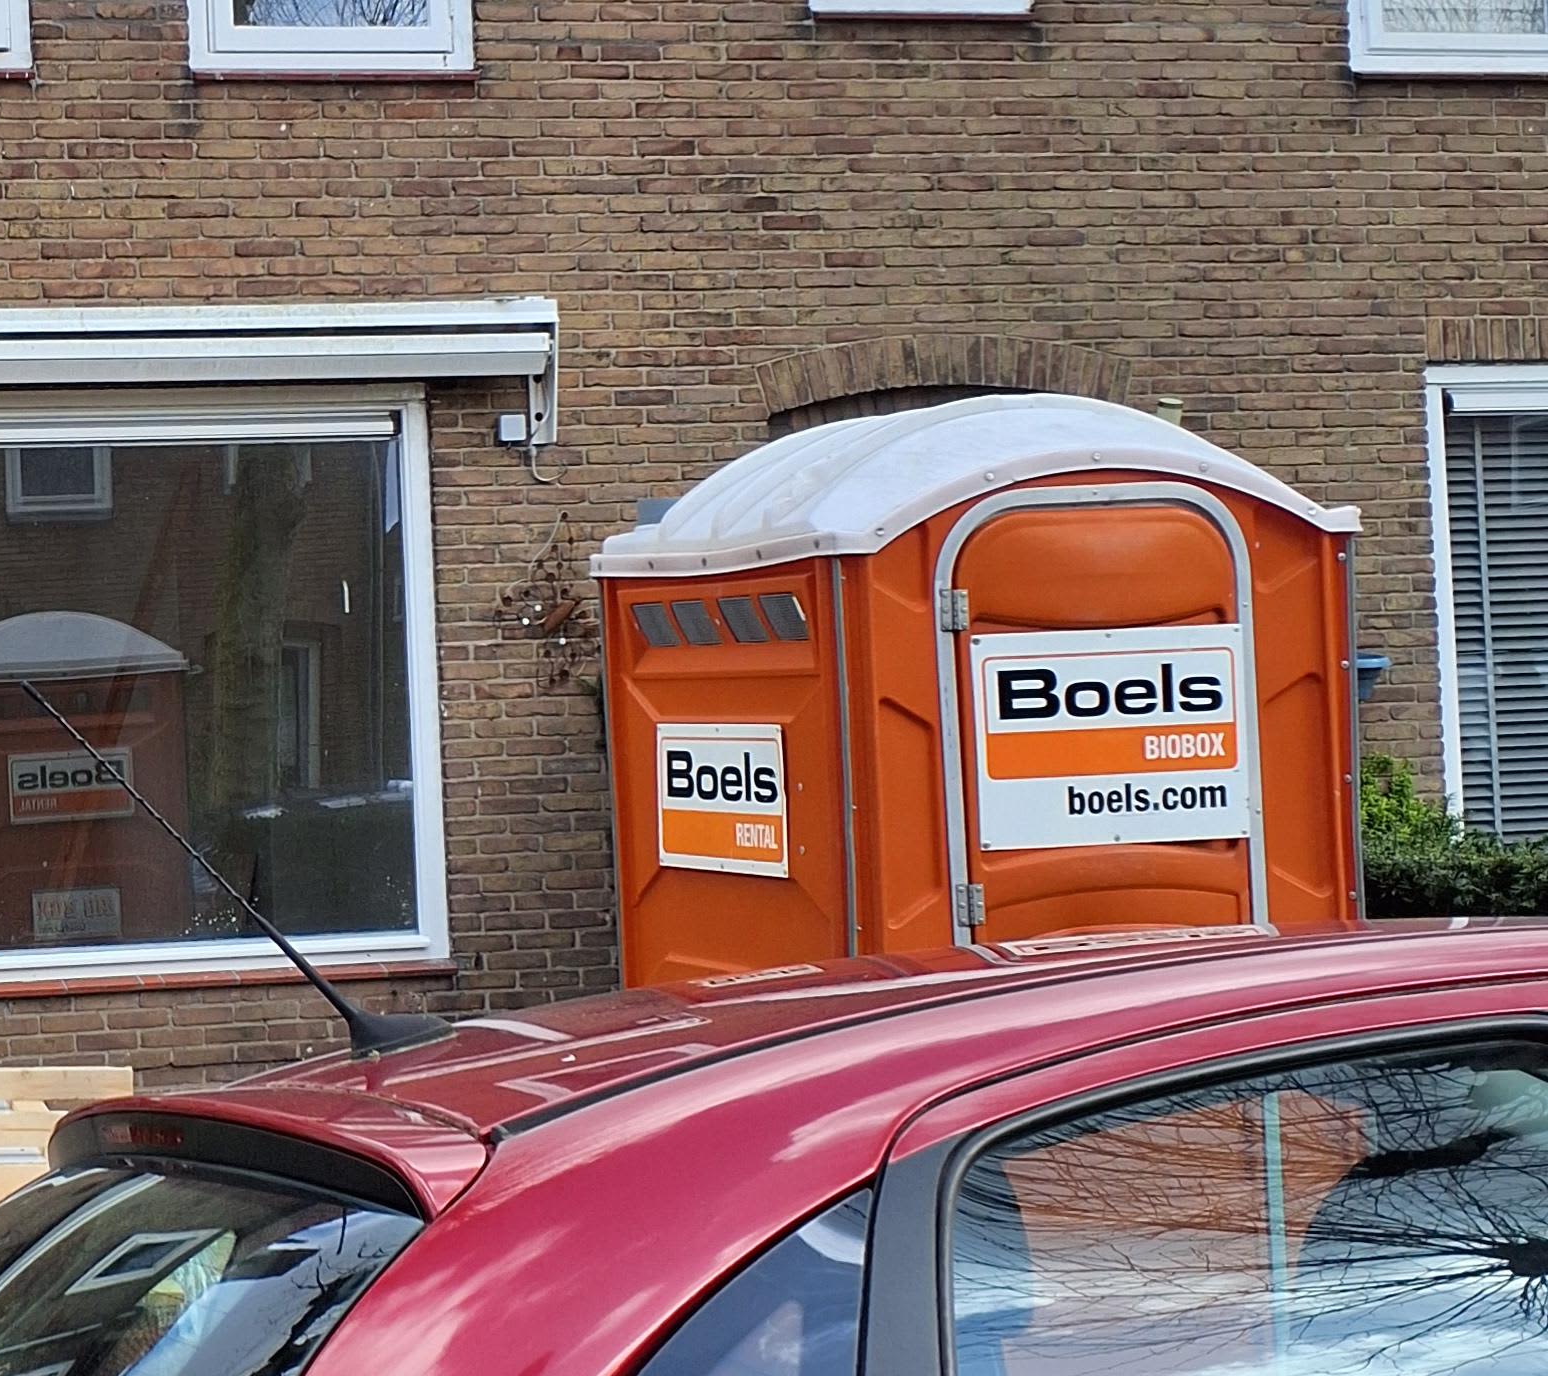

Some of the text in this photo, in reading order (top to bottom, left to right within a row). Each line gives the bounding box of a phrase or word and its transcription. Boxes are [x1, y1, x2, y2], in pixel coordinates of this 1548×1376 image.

[997, 663, 1224, 720] Boels
[1143, 732, 1226, 760] BIOBOX
[666, 750, 779, 803] Boels
[1067, 782, 1228, 816] boels.com
[735, 822, 779, 850] RENTAL
